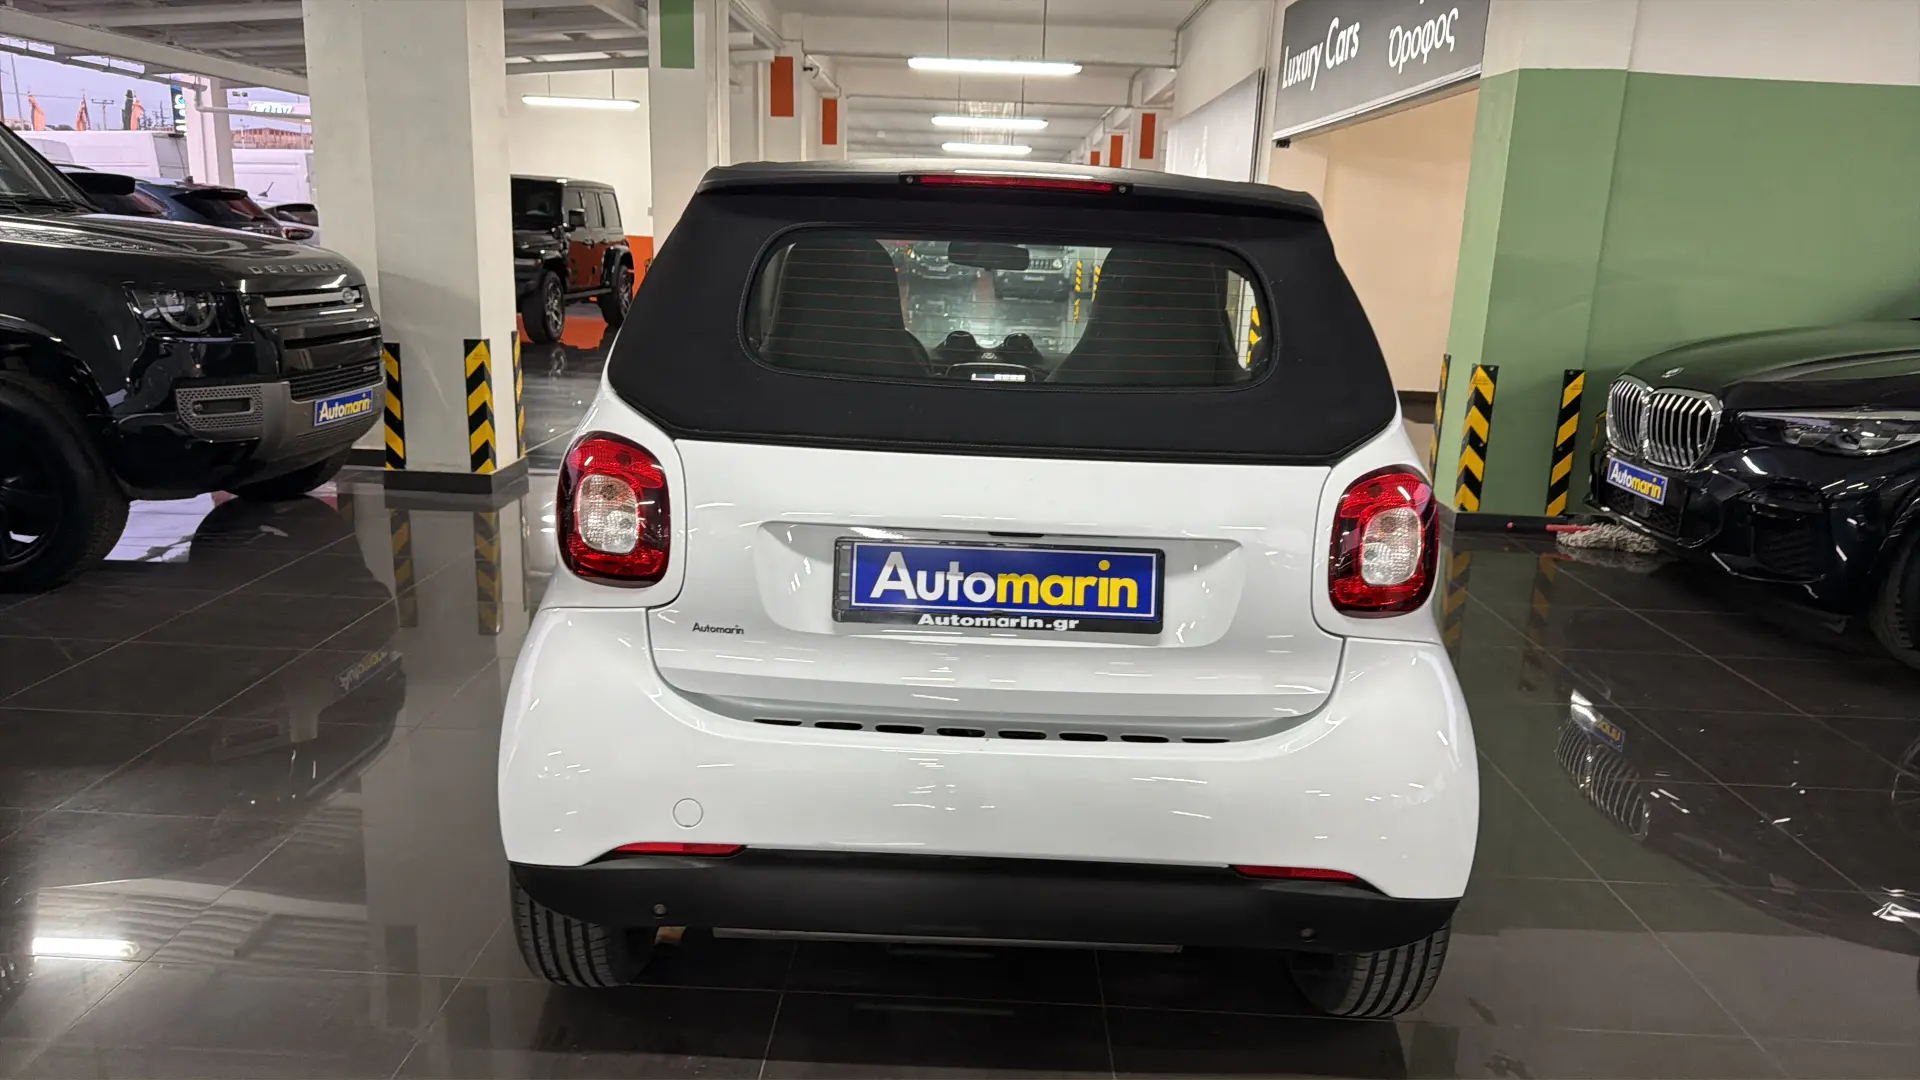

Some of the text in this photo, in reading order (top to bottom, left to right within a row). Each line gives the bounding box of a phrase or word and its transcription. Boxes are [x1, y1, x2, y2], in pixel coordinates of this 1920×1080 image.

[1282, 17, 1360, 91] Luxury Cars
[319, 392, 370, 422] Automarin
[1610, 462, 1662, 499] Automarin
[870, 551, 1138, 608] Automarin
[692, 622, 744, 635] Automarin
[918, 613, 1079, 631] Automarin.gr
